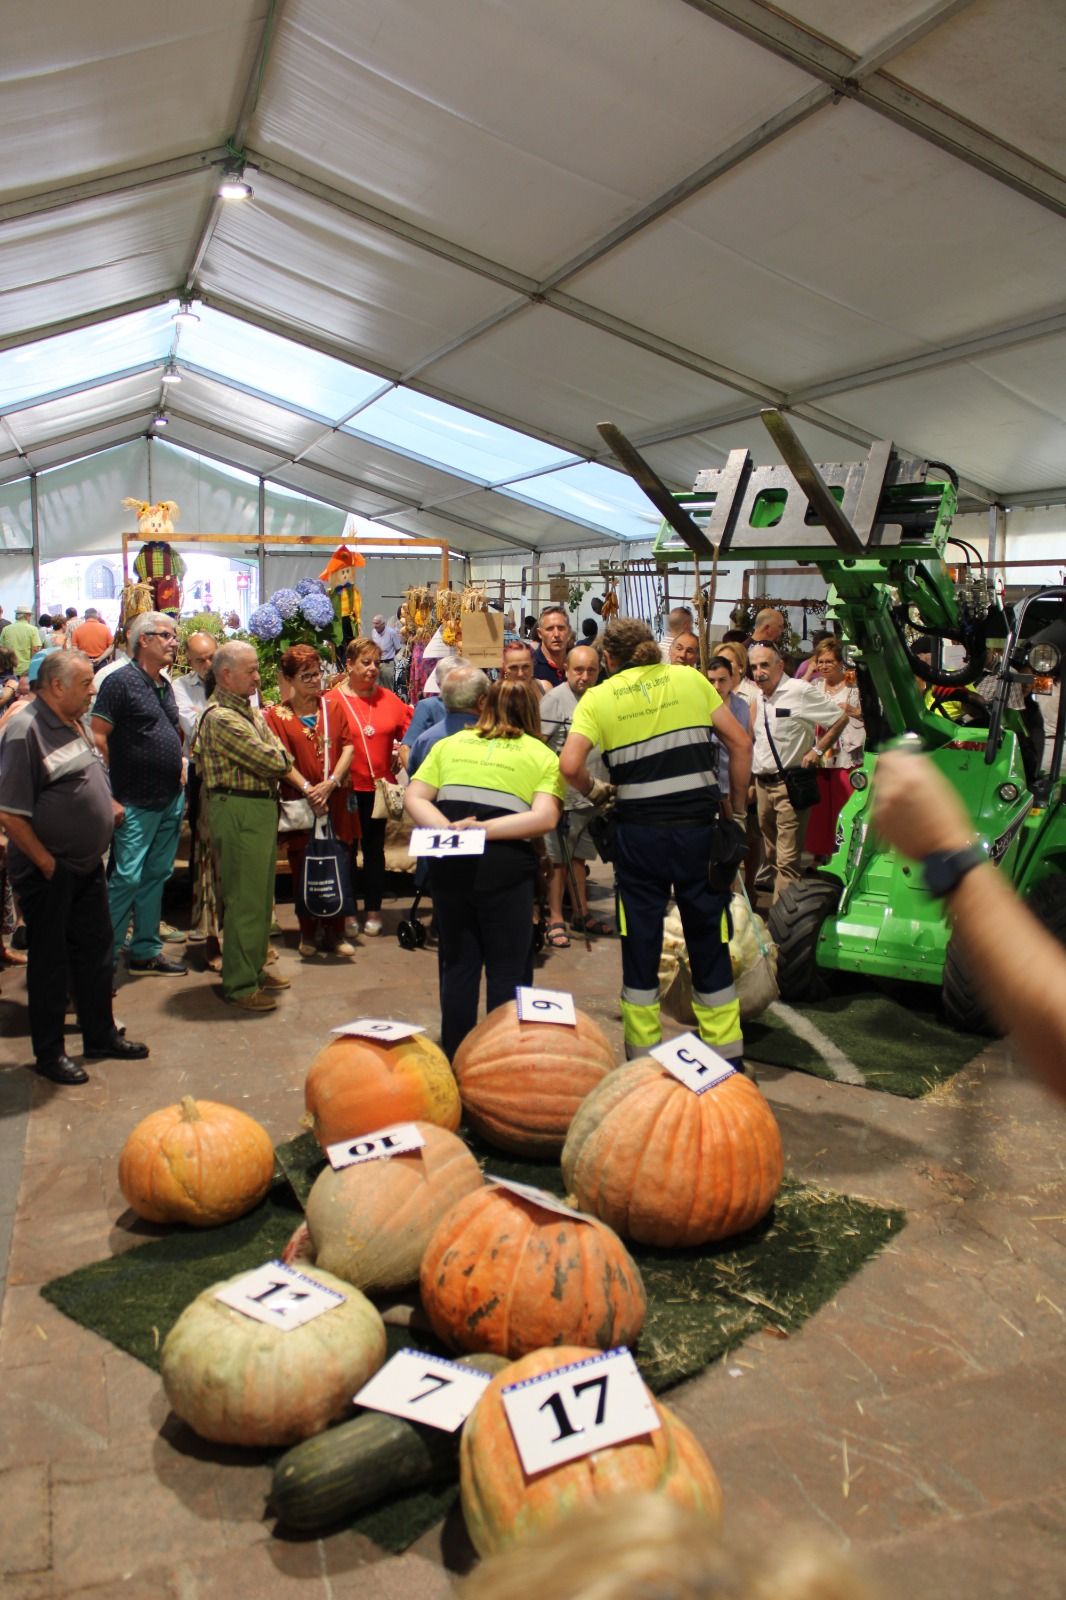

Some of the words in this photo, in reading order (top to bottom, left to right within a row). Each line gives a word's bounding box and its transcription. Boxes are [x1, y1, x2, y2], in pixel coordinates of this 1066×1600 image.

[426, 834, 465, 850] 14
[676, 1048, 709, 1077] 5
[348, 1133, 402, 1155] 10
[407, 1372, 455, 1404] 7
[538, 1374, 609, 1444] 17
